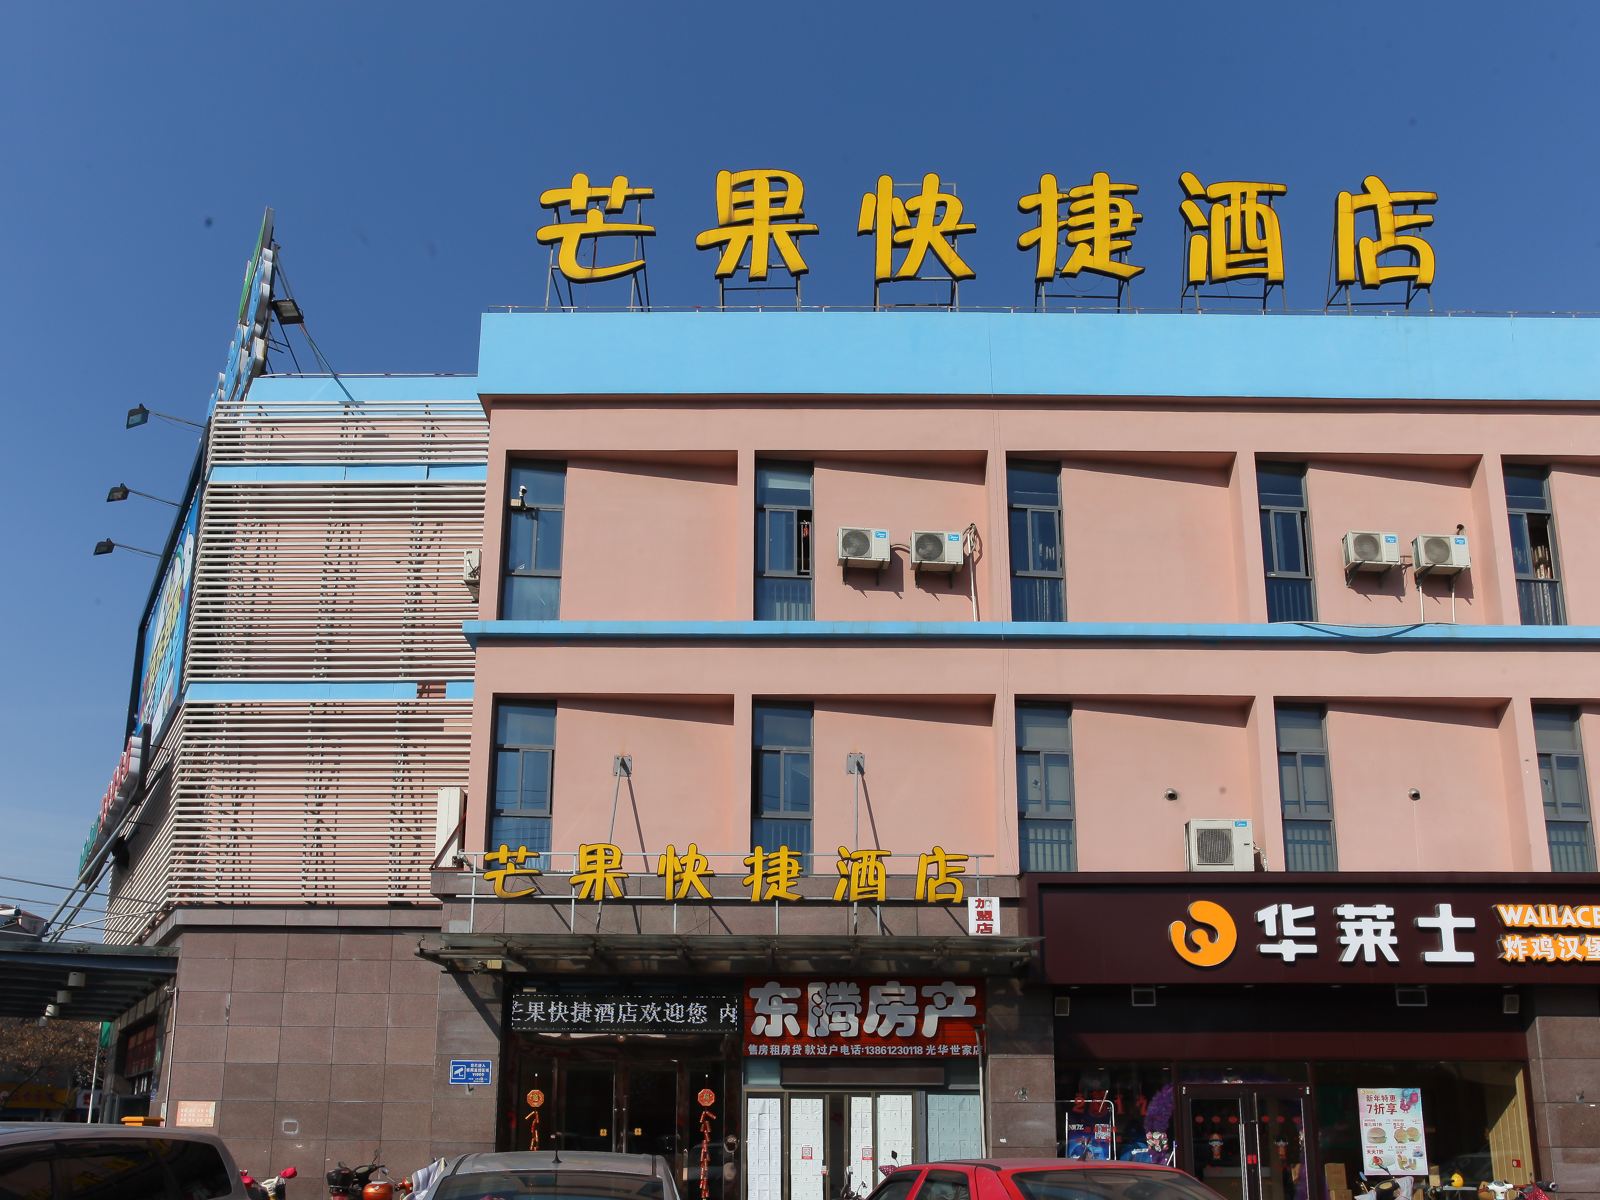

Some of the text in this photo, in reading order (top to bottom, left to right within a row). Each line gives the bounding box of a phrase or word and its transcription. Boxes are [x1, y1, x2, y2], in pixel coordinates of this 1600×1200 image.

[536, 168, 1438, 286] 芒果快捷酒店
[482, 842, 970, 905] 芒果快捷酒店
[1256, 903, 1477, 964] 华莱士
[748, 980, 977, 1038] 东腾房产
[1366, 1103, 1398, 1115] 7折享
